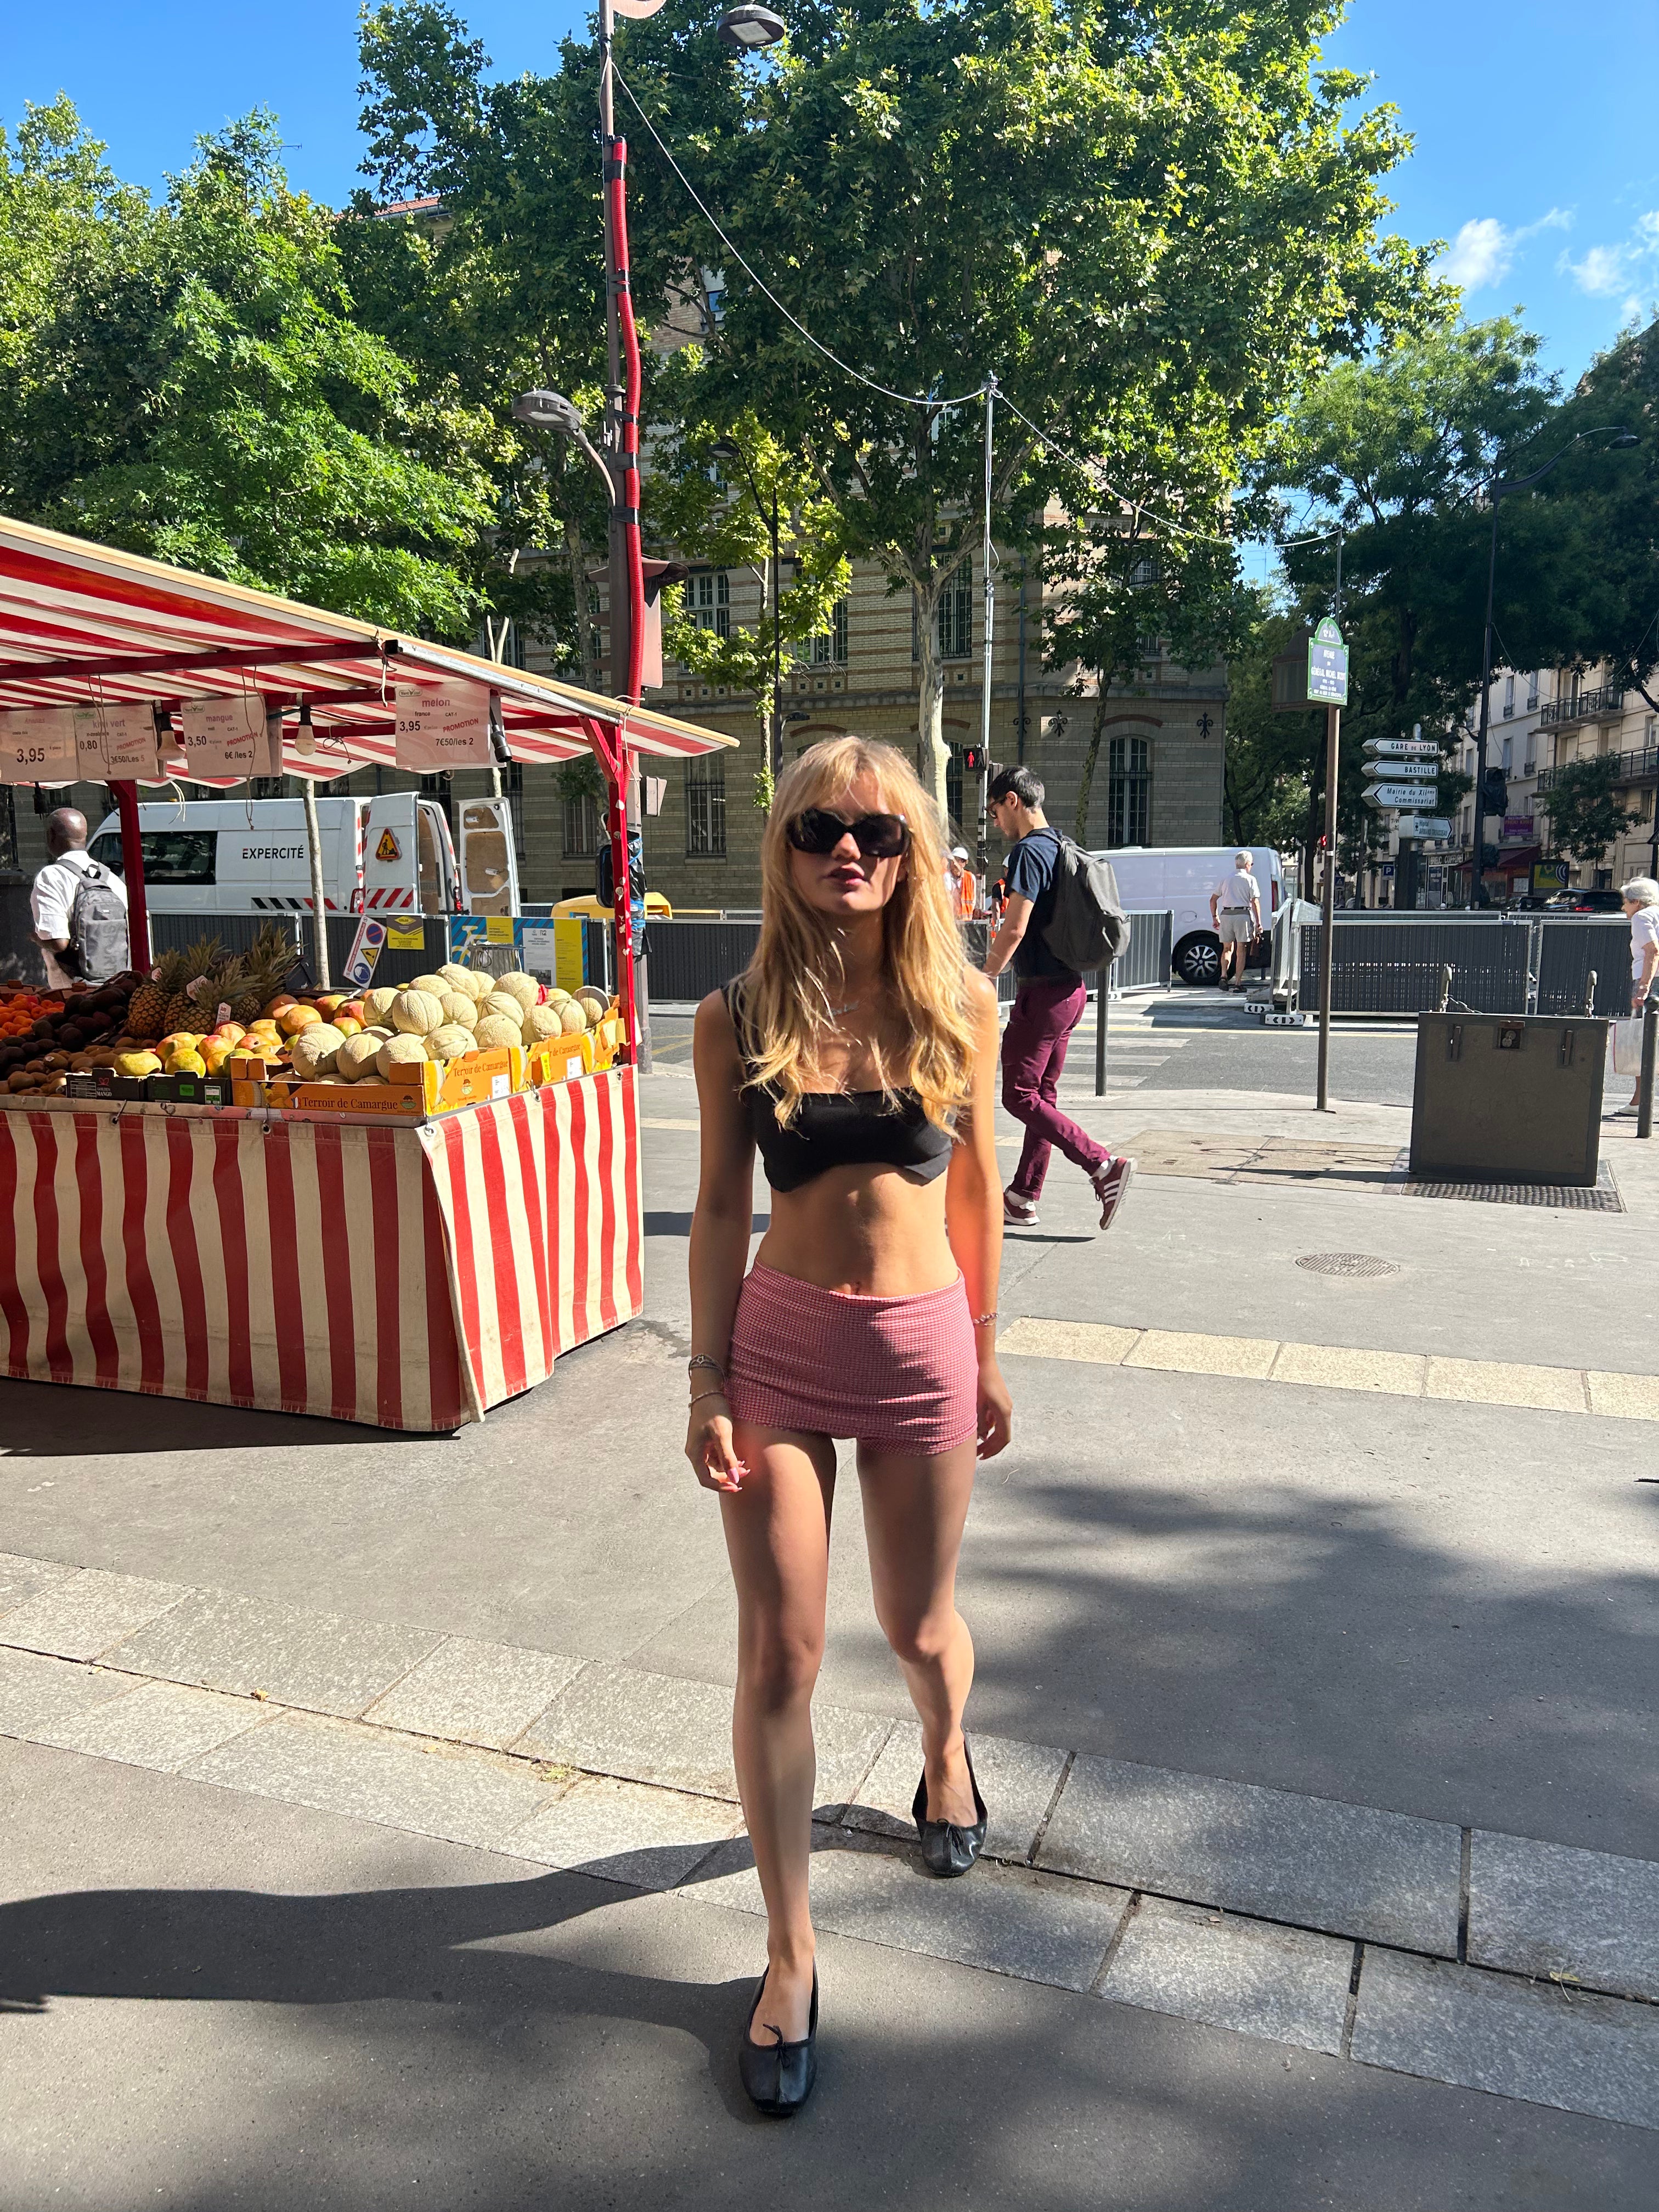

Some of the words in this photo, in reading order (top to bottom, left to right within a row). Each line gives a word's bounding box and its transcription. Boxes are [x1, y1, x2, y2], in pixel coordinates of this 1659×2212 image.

[422, 697, 450, 708] melon
[110, 719, 126, 727] vert
[206, 715, 233, 723] mangue
[399, 720, 420, 733] 3,95
[443, 718, 479, 733] PROMOTION
[116, 737, 146, 751] PROMOTION
[188, 736, 207, 748] 3,50
[227, 732, 258, 747] PROMOTION
[436, 738, 467, 747] 7€50/les
[469, 737, 474, 746] 2
[80, 740, 98, 752] 0,80
[1391, 742, 1408, 751] GARE
[16, 747, 45, 765] 3,95
[224, 751, 233, 759] 6€
[1404, 766, 1435, 775] BASTILLE
[1395, 796, 1435, 805] Commissariat
[242, 845, 304, 859] EXPERCITÉ
[552, 1047, 558, 1057] de
[453, 1066, 473, 1077] Terroir
[474, 1064, 482, 1074] de
[482, 1060, 509, 1071] Camargue
[302, 1097, 335, 1108] Terroir
[337, 1098, 348, 1109] de
[351, 1099, 398, 1111] Camargue
